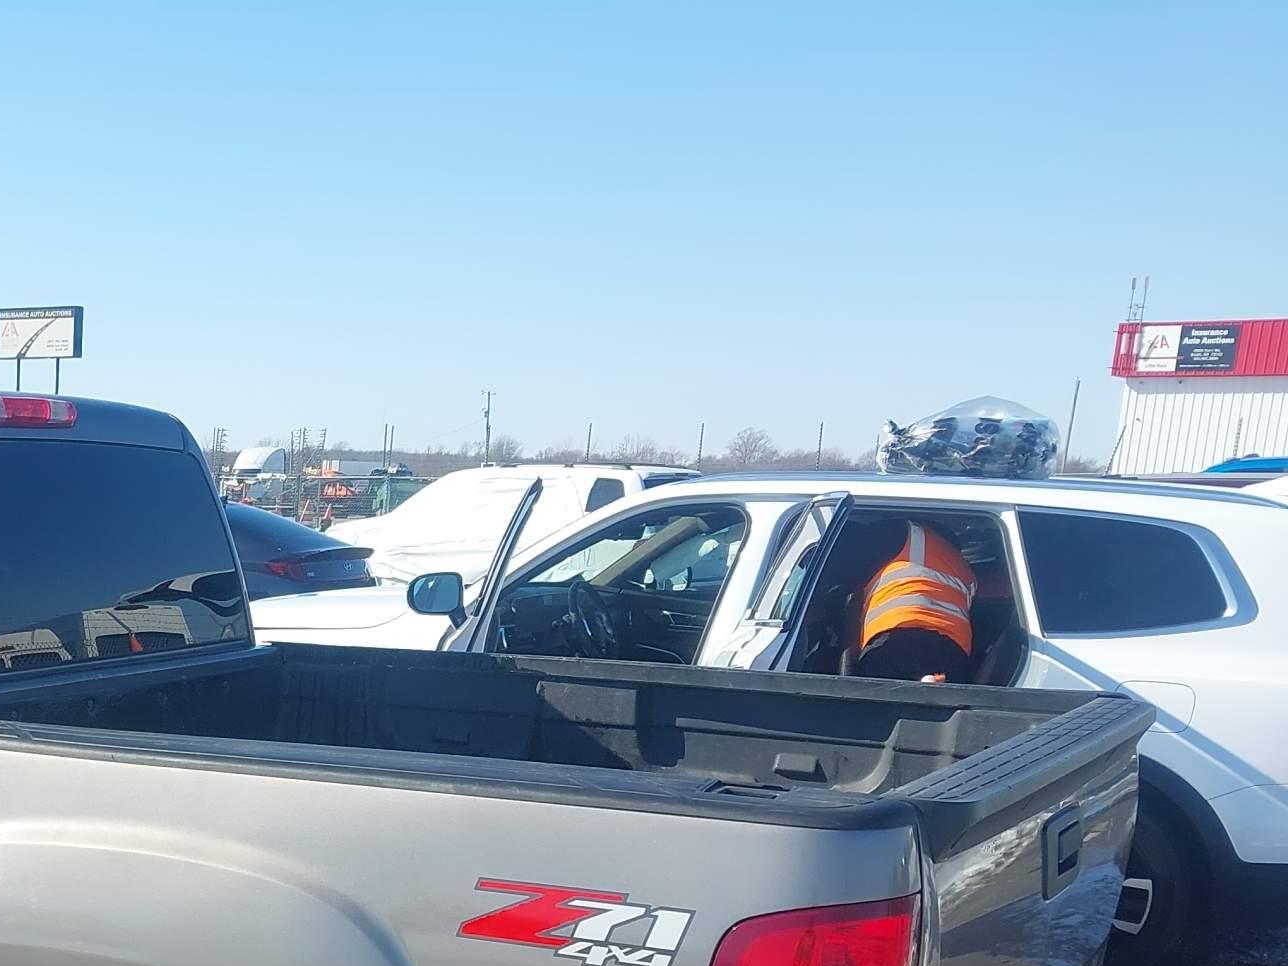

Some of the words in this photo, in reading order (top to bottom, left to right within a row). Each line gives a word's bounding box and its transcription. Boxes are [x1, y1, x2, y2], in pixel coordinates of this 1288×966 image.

[0, 311, 30, 319] INSURANCE
[1191, 328, 1229, 336] Insurance
[1182, 337, 1201, 345] Auto
[1201, 336, 1235, 345] Auctions
[456, 876, 697, 953] Z71
